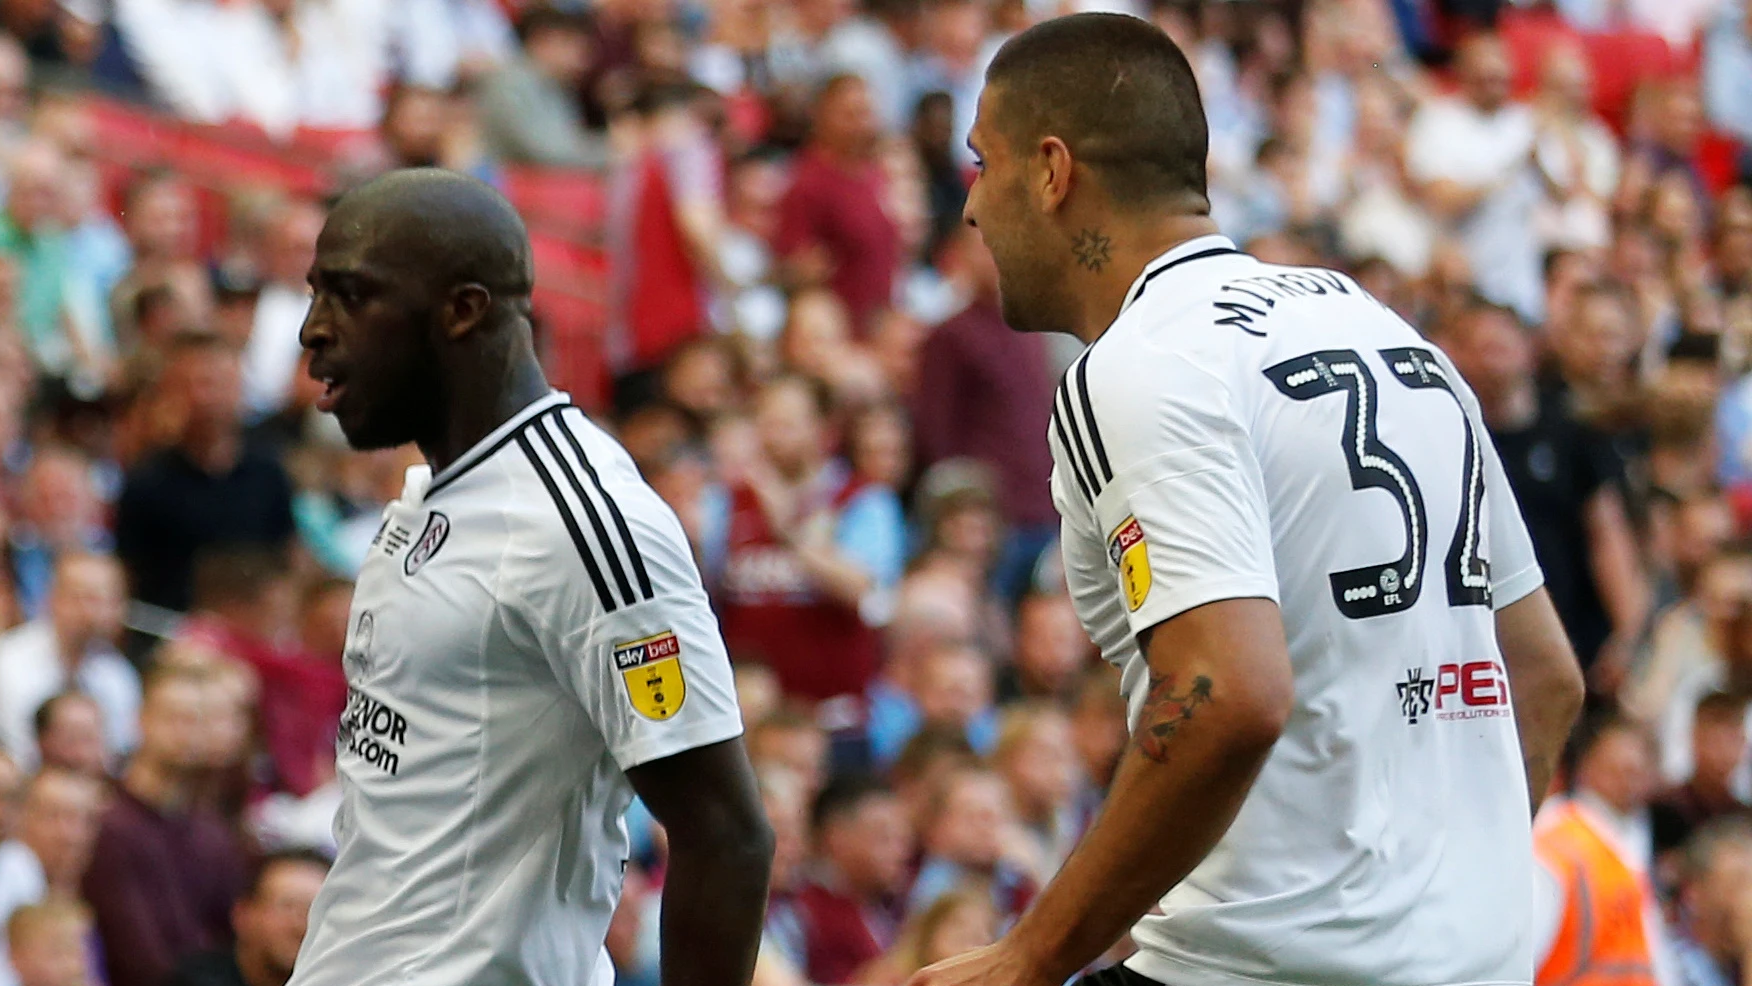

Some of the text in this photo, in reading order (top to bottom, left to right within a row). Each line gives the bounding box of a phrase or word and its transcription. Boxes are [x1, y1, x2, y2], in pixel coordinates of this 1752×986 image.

[1213, 271, 1353, 337] MITROV
[1262, 347, 1492, 619] 32
[1383, 594, 1402, 606] EFL
[618, 637, 676, 667] sky bet
